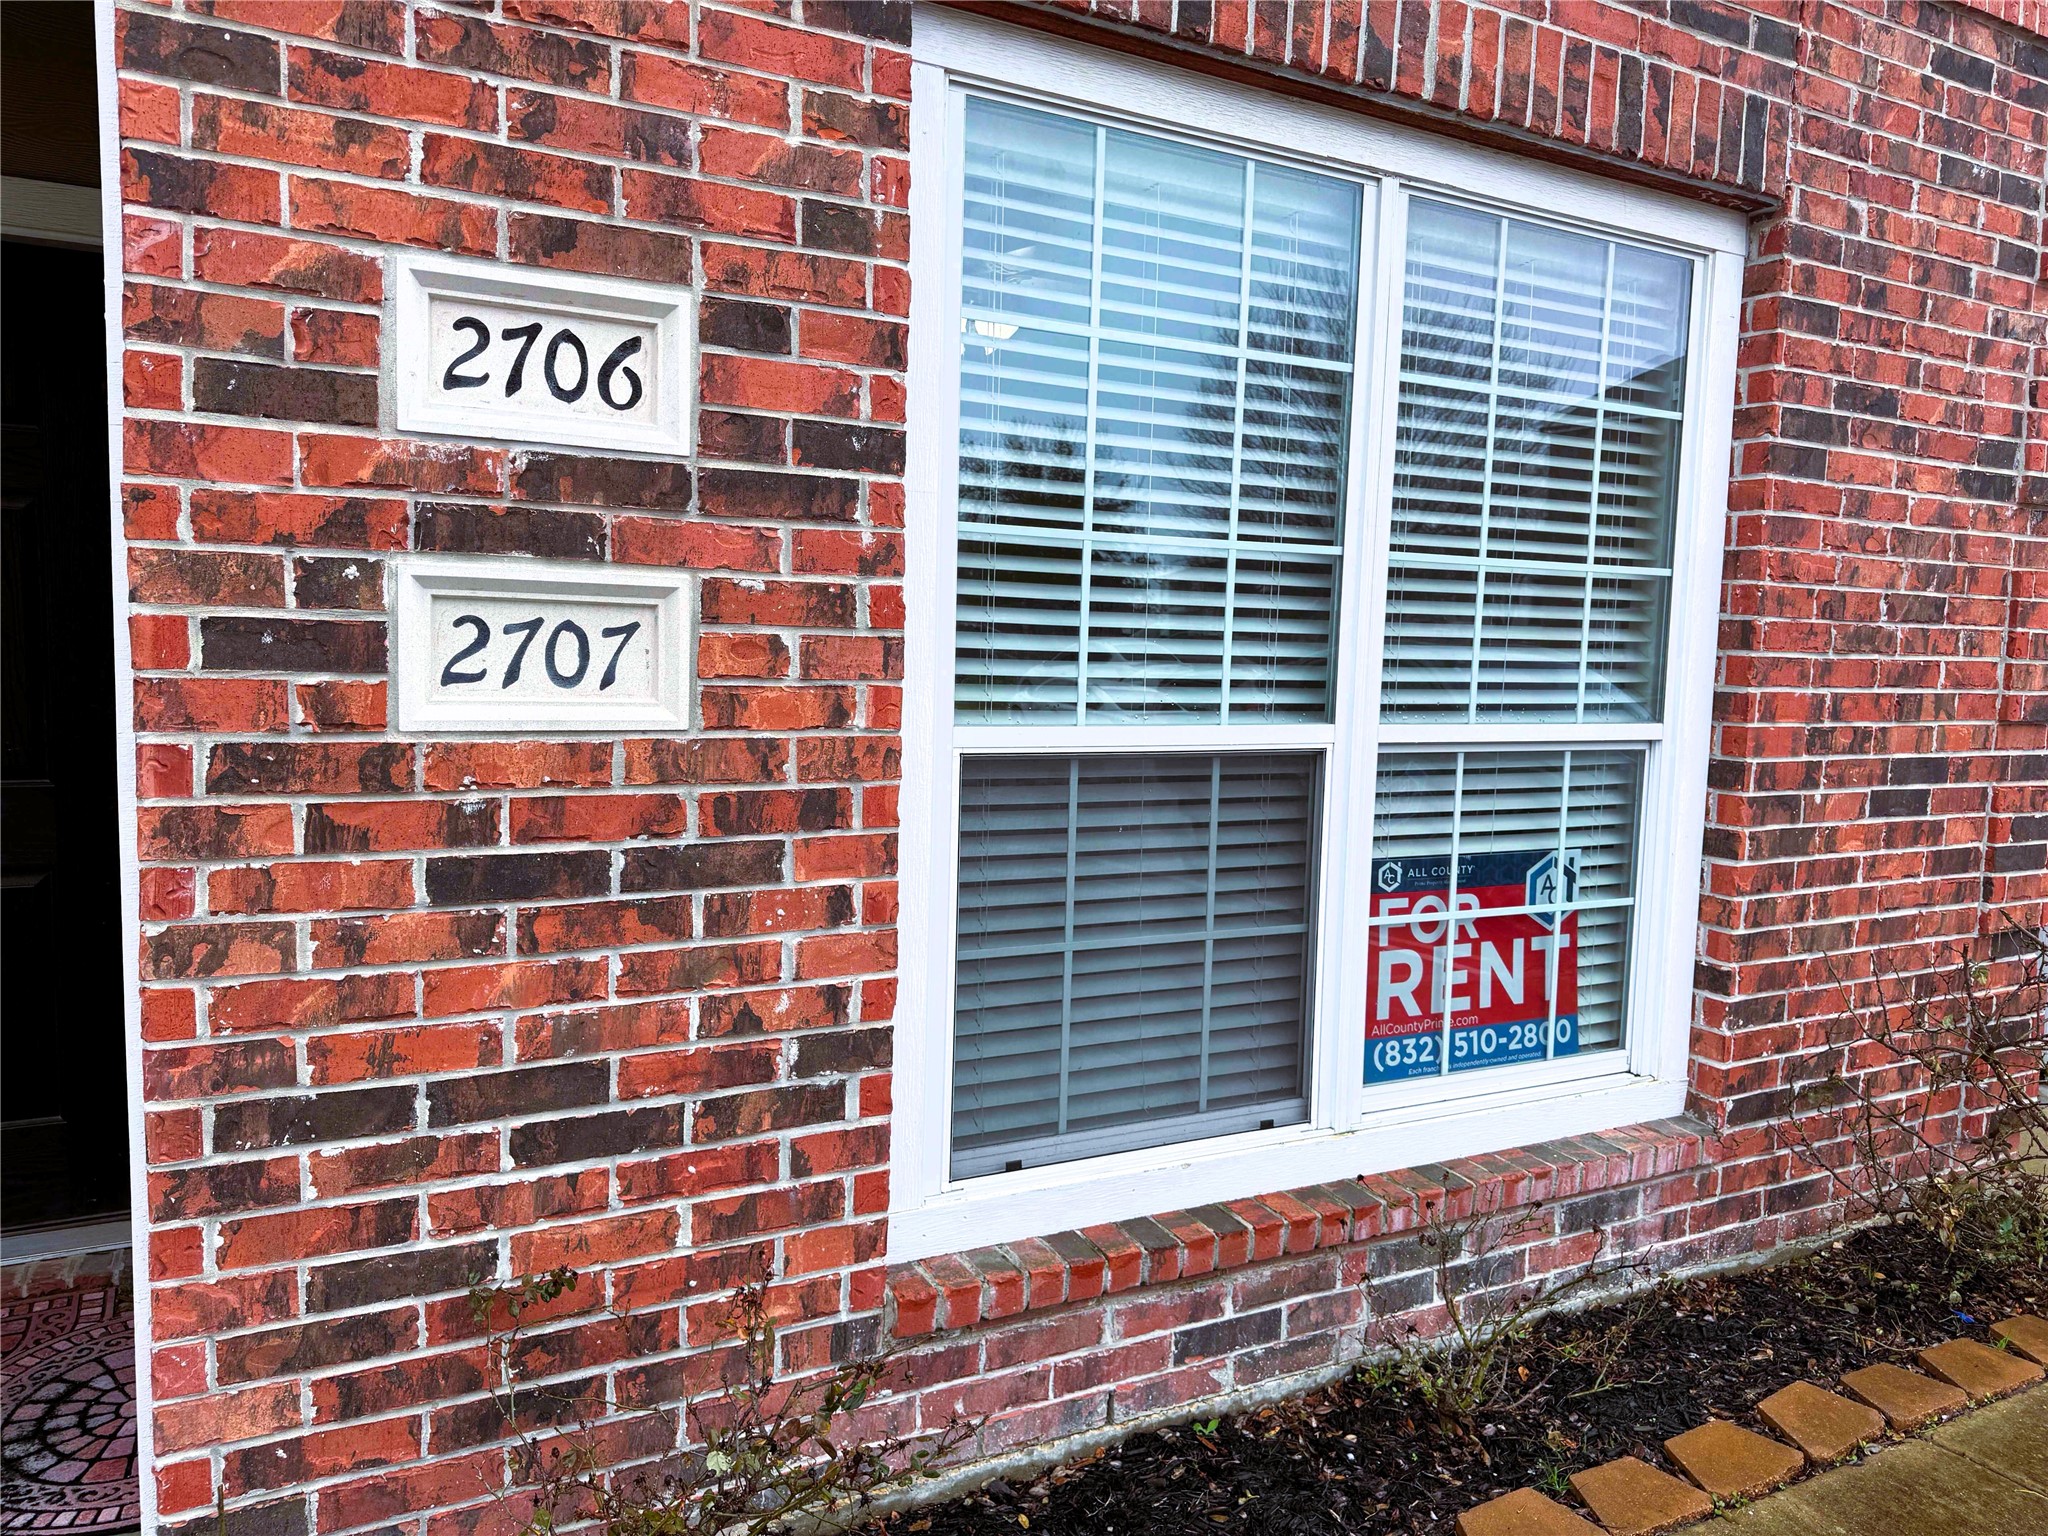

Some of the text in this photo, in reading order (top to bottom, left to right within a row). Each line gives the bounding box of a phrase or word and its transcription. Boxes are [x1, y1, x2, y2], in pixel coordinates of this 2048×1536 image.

[443, 315, 642, 411] 2706
[440, 614, 642, 691] 2707
[1408, 868, 1428, 878] ALL
[1379, 893, 1480, 947] FOR
[1376, 934, 1570, 1021] RENT
[1373, 1018, 1571, 1072] (832) 510-2800
[1408, 1066, 1422, 1075] Each
